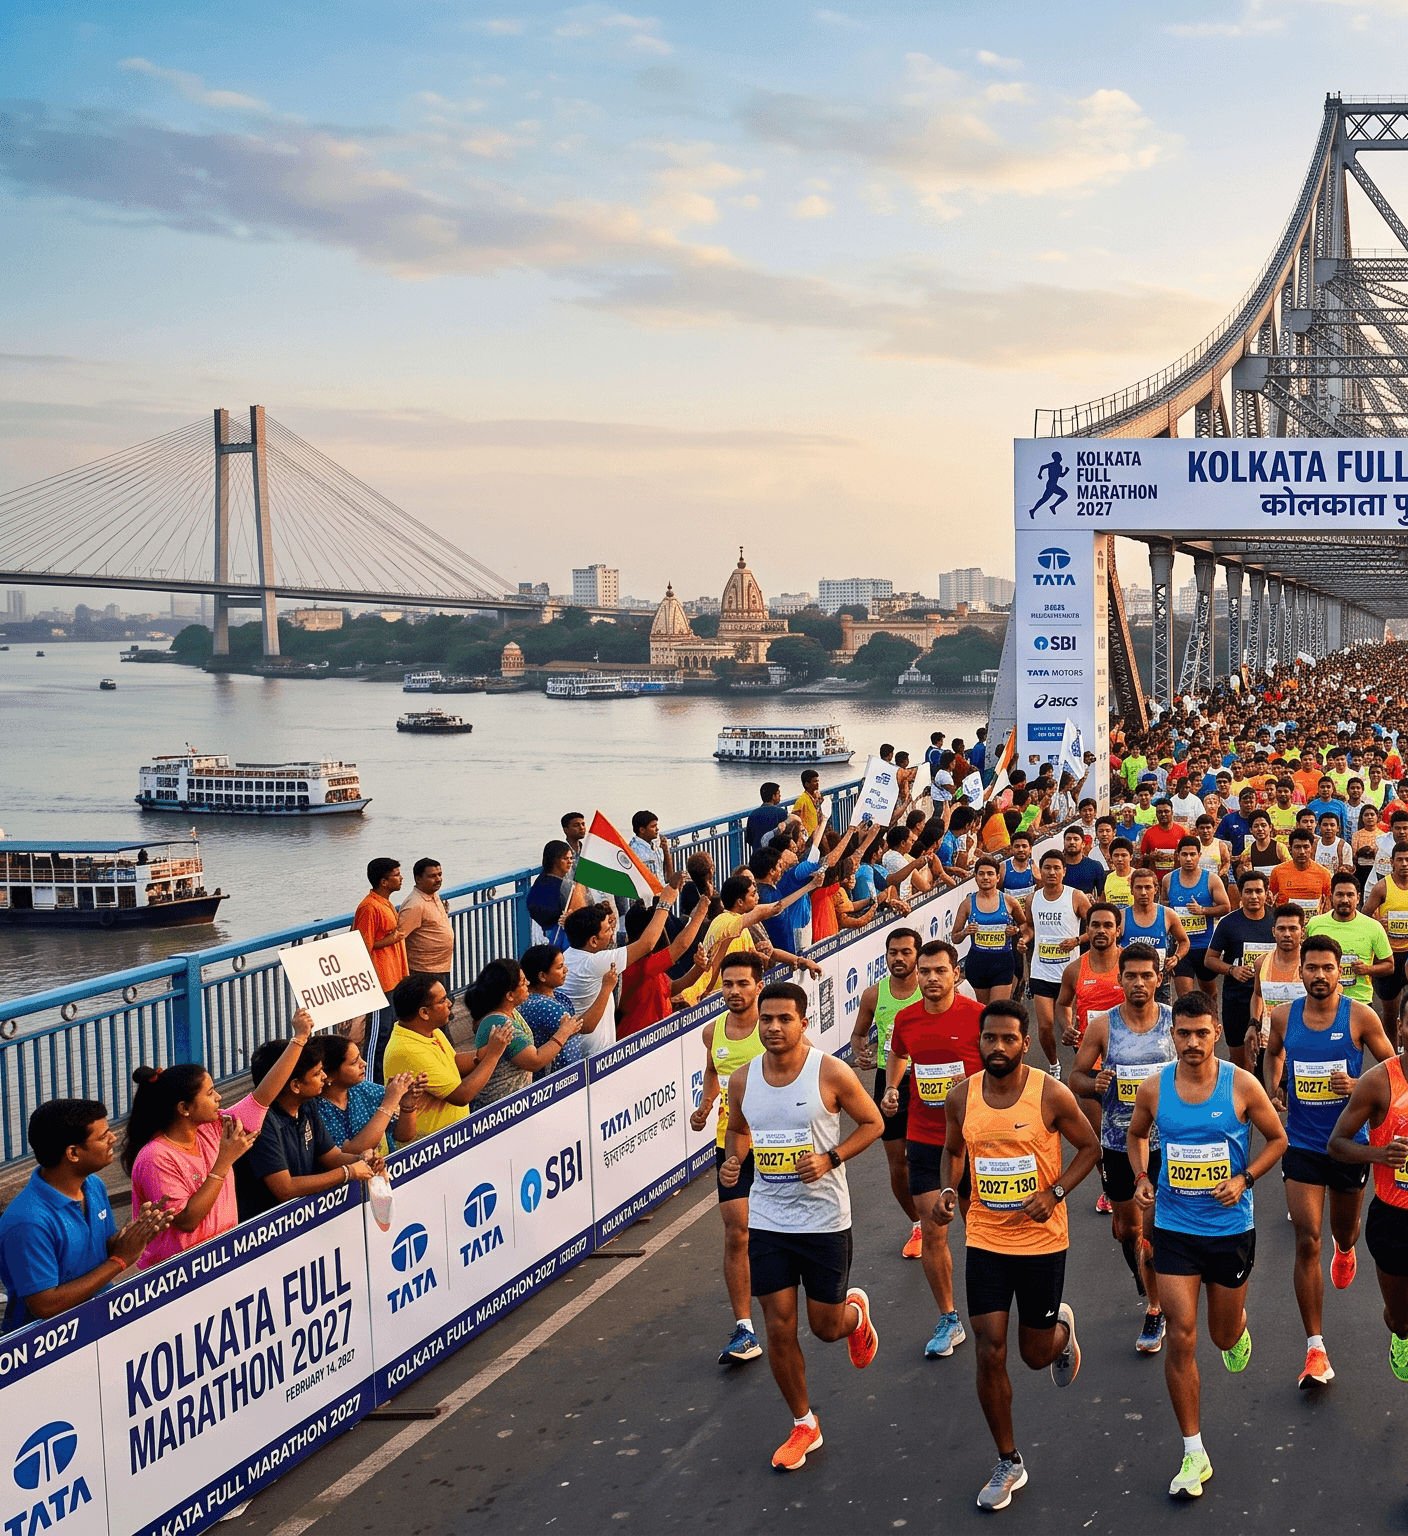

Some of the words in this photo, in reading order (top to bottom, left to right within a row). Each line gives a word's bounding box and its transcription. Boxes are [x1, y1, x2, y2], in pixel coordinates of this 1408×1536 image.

[1077, 451, 1142, 466] KOLKATA
[1077, 468, 1111, 482] FULL
[1188, 450, 1327, 483] KOLKATA
[1077, 484, 1158, 500] MARATHON
[1077, 501, 1112, 516] 2027
[1259, 486, 1387, 516] कोलकाता
[1033, 574, 1076, 586] TATA
[1050, 636, 1076, 651] SBI
[1051, 669, 1083, 677] MOTORS
[1048, 695, 1078, 707] asics
[319, 954, 341, 977] GO
[301, 970, 376, 1009] RUNNERS!
[600, 1108, 632, 1141] TATA
[634, 1080, 676, 1122] MOTORS
[387, 1142, 441, 1181] KOLKATA
[443, 1127, 471, 1153] FULL
[473, 1096, 530, 1138] MARATHON
[545, 1140, 583, 1200] SBI
[109, 1267, 188, 1320] KOLKATA
[191, 1248, 231, 1282] FULL
[234, 1207, 314, 1258] MARATHON
[318, 1184, 349, 1213] 2027
[460, 1225, 504, 1268] TATA
[387, 1267, 437, 1314] TATA
[34, 1317, 79, 1358] 2027
[125, 1286, 276, 1419] KOLKATA
[283, 1247, 351, 1328] FULL
[387, 1338, 444, 1389] KOLKATA
[446, 1319, 475, 1350] FULL
[476, 1276, 533, 1327] MARATHON
[535, 1262, 556, 1288] 2027
[129, 1338, 286, 1475] MARATHON
[292, 1299, 352, 1377] 2027
[286, 1367, 324, 1403] FEBRUARY
[207, 1475, 245, 1513] FULL
[248, 1424, 327, 1484] MARATHON
[330, 1393, 361, 1426] 2027
[4, 1475, 93, 1536] TATA
